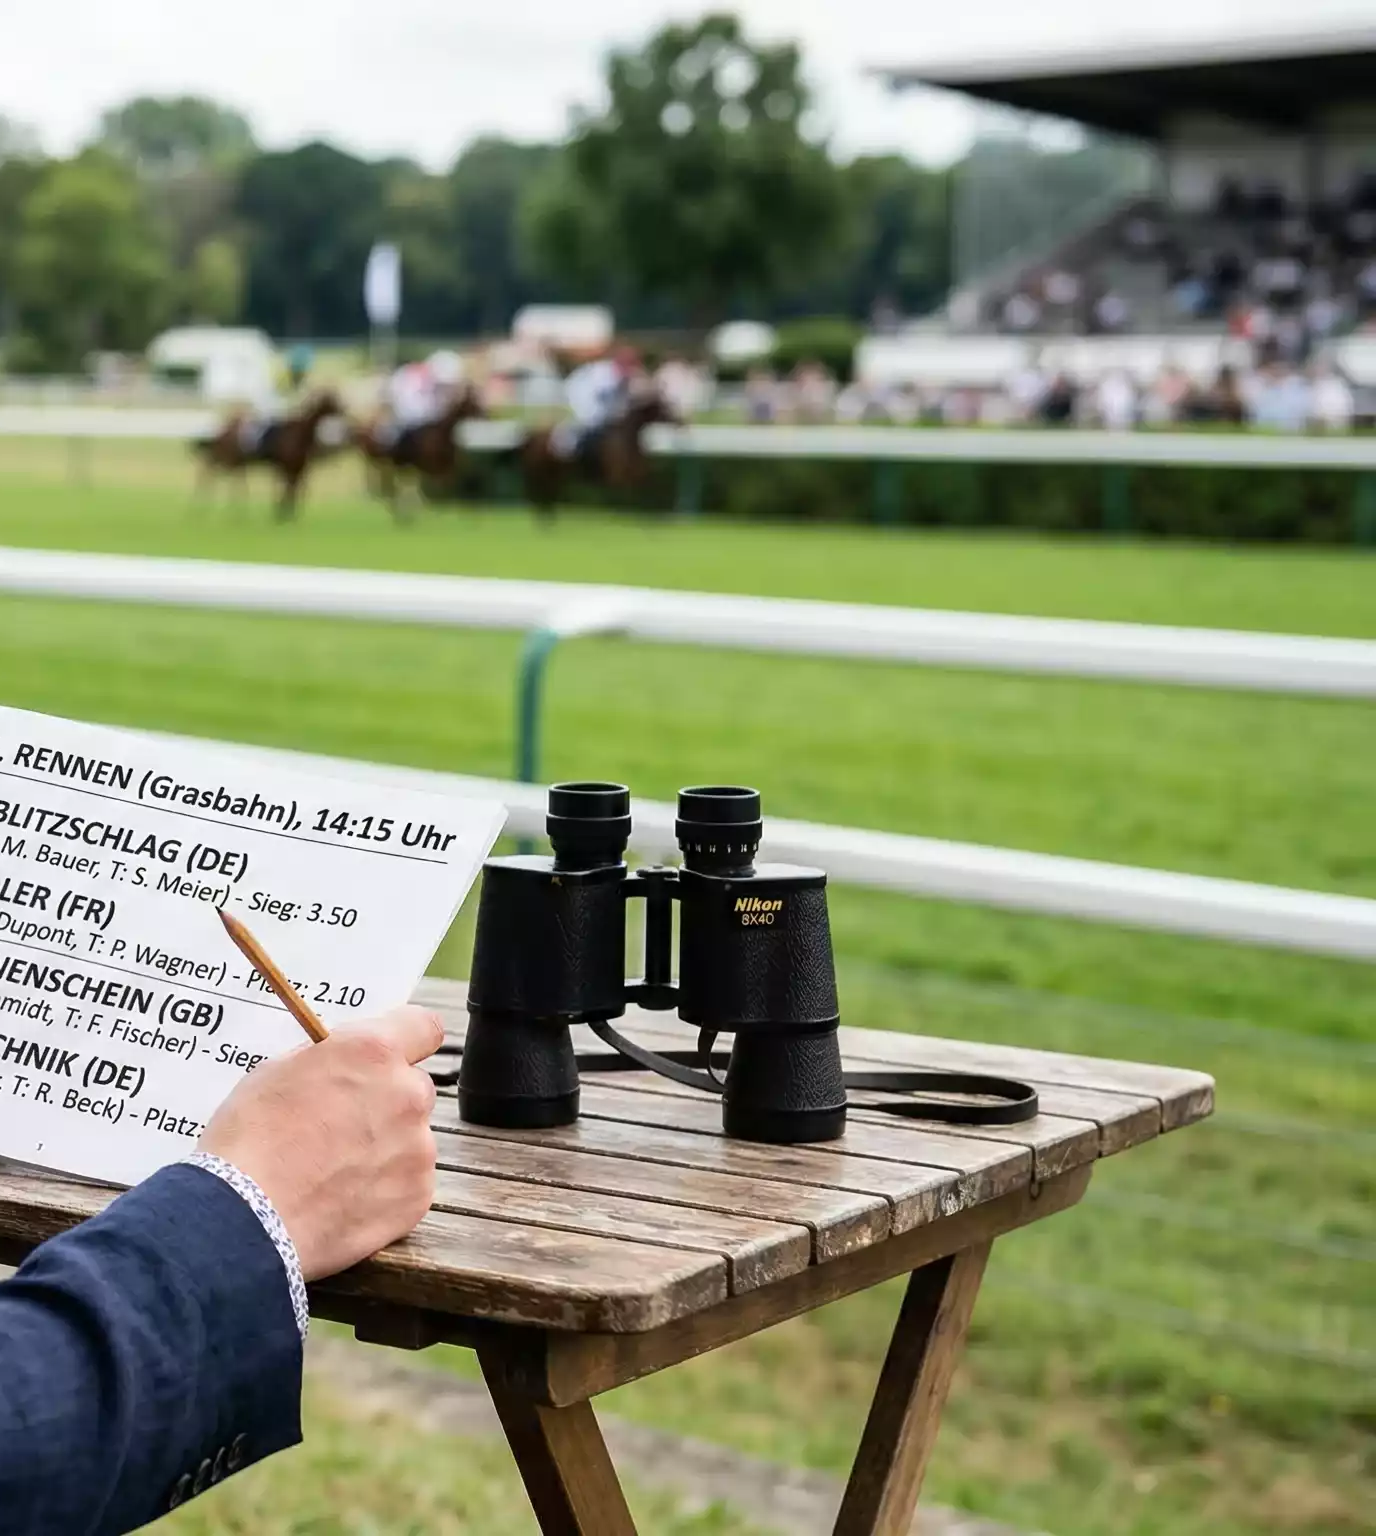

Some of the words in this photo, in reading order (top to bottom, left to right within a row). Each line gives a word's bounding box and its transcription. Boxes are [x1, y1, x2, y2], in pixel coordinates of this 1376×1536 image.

[12, 743, 134, 790] RENNEN
[138, 770, 302, 831] (Grasbahn),
[311, 808, 395, 842] 14:15
[401, 822, 457, 852] Uhr
[0, 835, 27, 859] M.
[35, 843, 101, 879] Bauer,
[110, 860, 128, 882] T:
[131, 866, 148, 888] S.
[156, 872, 230, 908] Meier)
[247, 891, 302, 922] Sieg:
[306, 902, 358, 928] 3.50
[186, 843, 249, 884] (DE)
[56, 890, 116, 931] (FR)
[734, 897, 783, 912] Nikon
[88, 932, 105, 954] T:
[109, 938, 127, 960] P.
[135, 943, 227, 987] Wagner)
[313, 981, 366, 1008] 2.10
[65, 1006, 83, 1029] T:
[86, 1013, 104, 1035] F.
[109, 1018, 197, 1061] Fischer)
[158, 993, 224, 1036] (GB)
[12, 1074, 30, 1098] T:
[34, 1081, 54, 1105] R.
[62, 1088, 125, 1125] Beck)
[82, 1055, 146, 1099] (DE)
